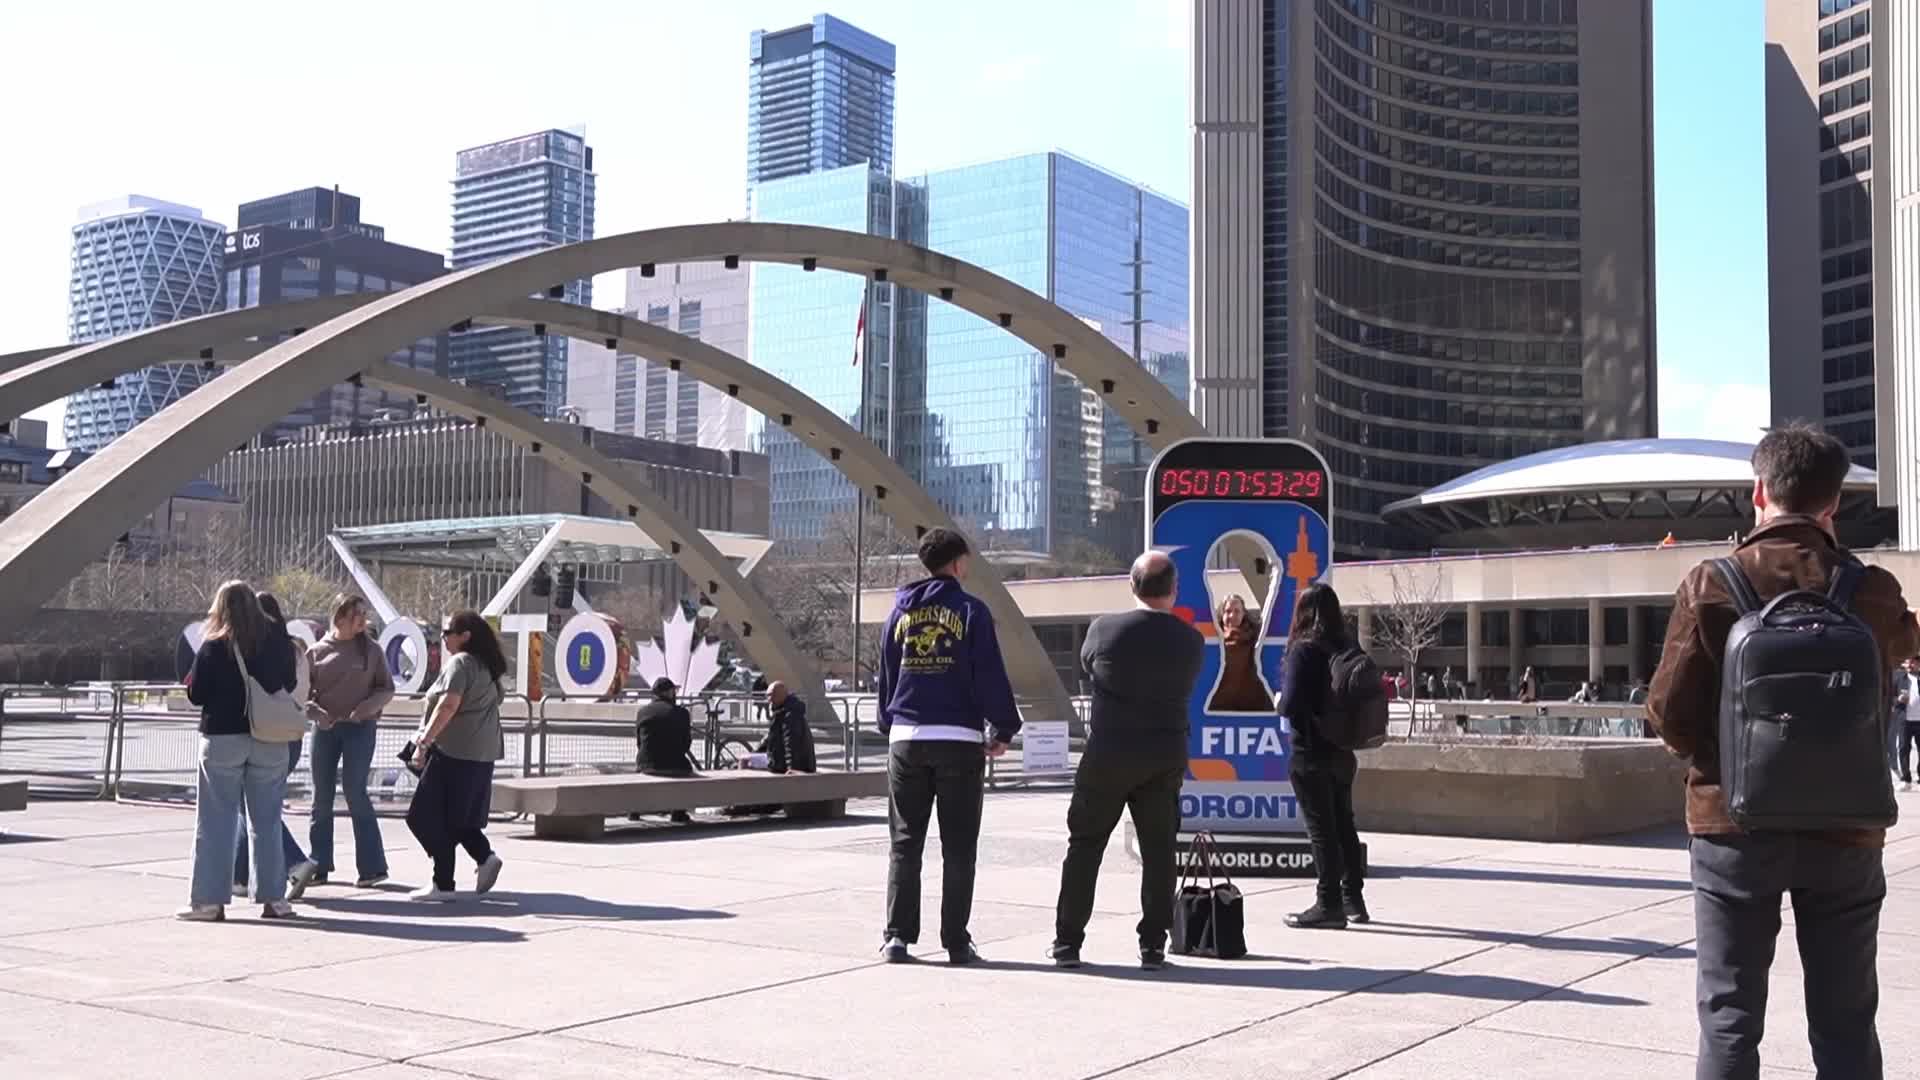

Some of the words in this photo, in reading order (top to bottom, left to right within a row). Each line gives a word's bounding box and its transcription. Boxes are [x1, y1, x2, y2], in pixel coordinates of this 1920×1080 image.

[1161, 470, 1209, 496] 050
[1215, 471, 1321, 497] 07:53:29
[1202, 727, 1284, 755] FIFA
[1179, 795, 1297, 819] ORONT
[1207, 852, 1273, 867] WORLD
[1276, 853, 1314, 868] CUP
